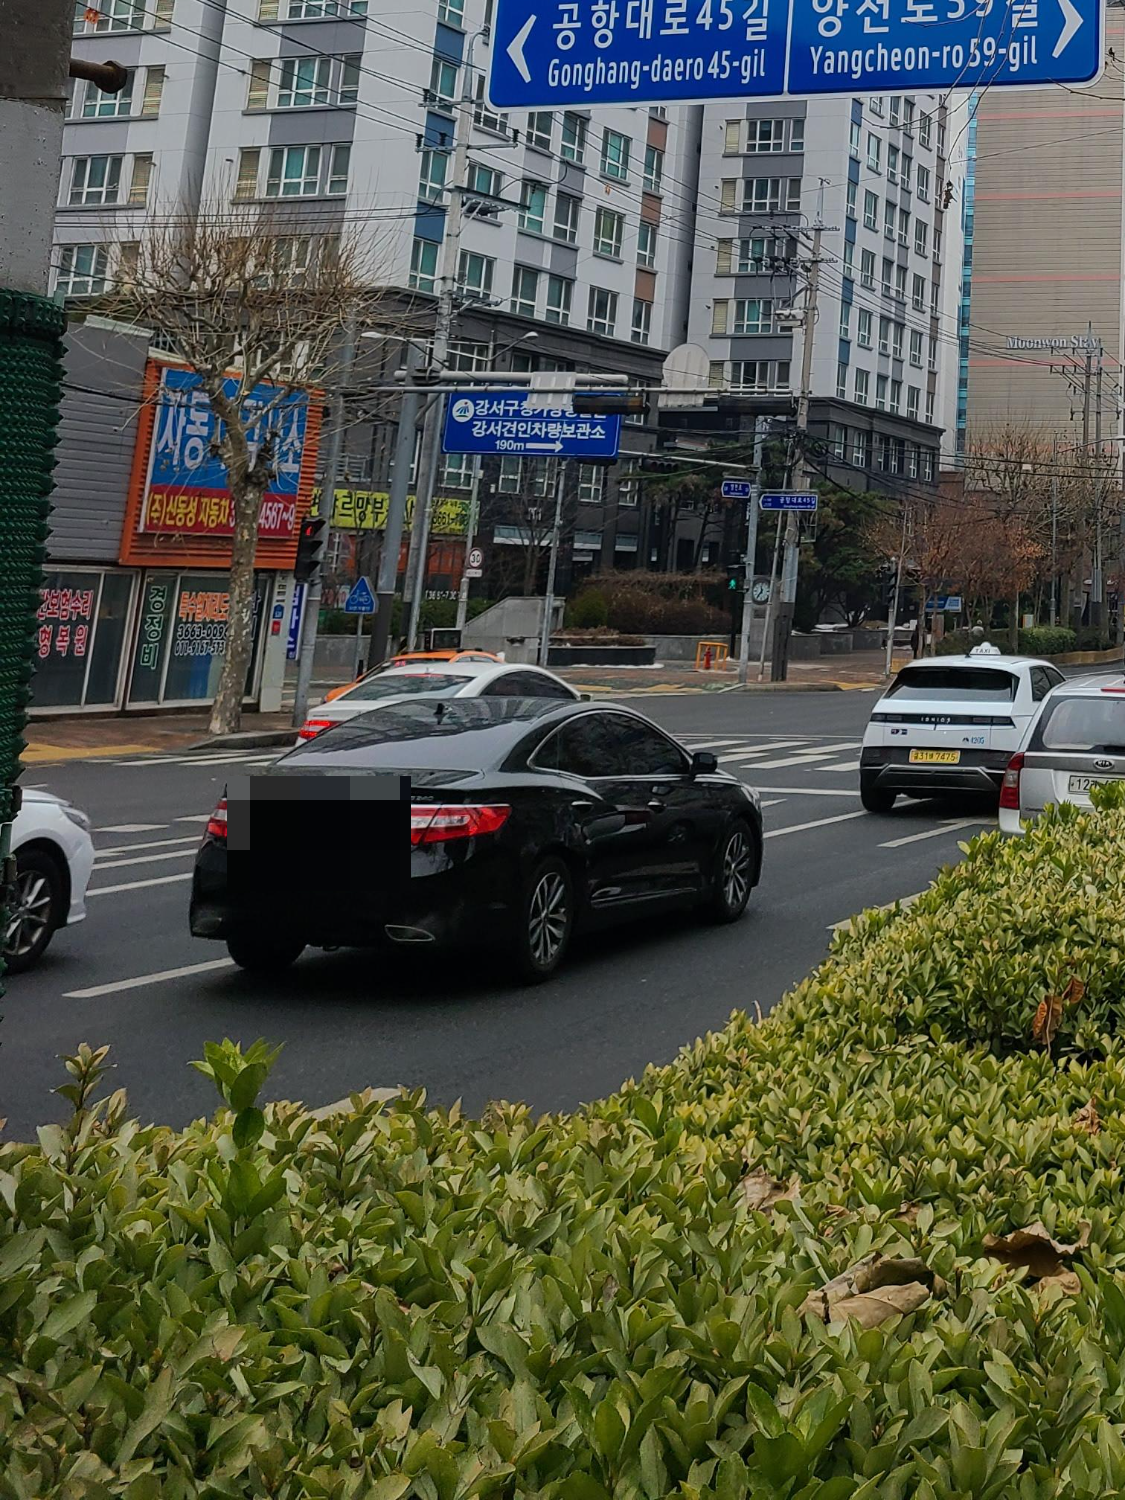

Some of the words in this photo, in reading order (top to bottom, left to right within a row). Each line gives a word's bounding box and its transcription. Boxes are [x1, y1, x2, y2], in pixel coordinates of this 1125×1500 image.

[548, 53, 701, 92] Gonghang-daero
[809, 40, 965, 79] Yangcheon-ro
[1006, 337, 1066, 349] Moonwon
[1070, 335, 1098, 348] Stay
[472, 420, 605, 439] 강서견인차량보관소
[495, 439, 525, 451] 190m
[146, 490, 198, 527] (주)신동성
[199, 497, 230, 529] 자동차
[471, 554, 481, 564] 30
[139, 585, 166, 670] 경정비
